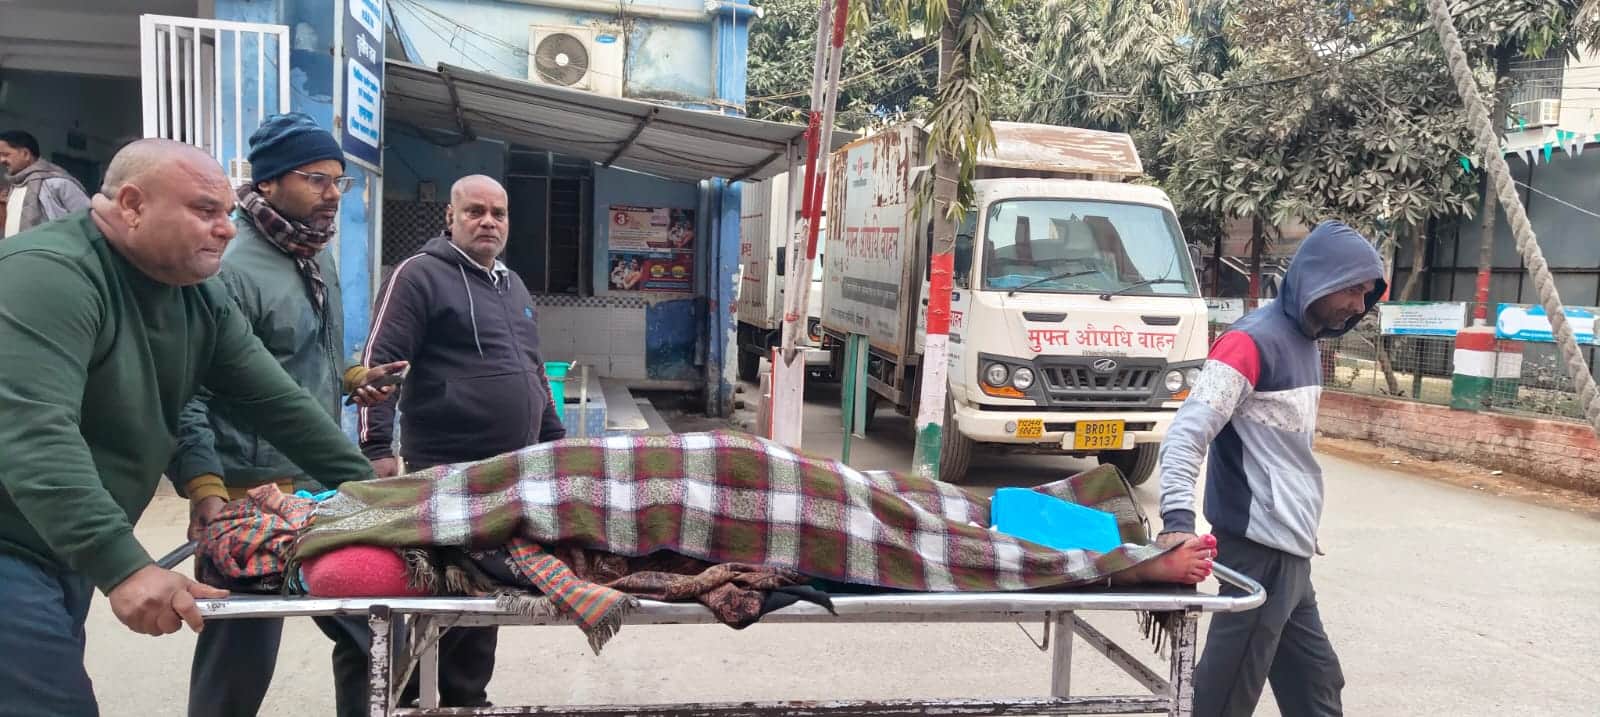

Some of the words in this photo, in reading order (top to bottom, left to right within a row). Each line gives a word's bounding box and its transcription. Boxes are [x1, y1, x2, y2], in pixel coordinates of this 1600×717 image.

[1028, 329, 1070, 352] मुफ्त
[1075, 324, 1134, 347] औषधि
[1137, 331, 1177, 352] वाहन
[1085, 423, 1118, 435] BR01G
[1084, 435, 1117, 447] P3137
